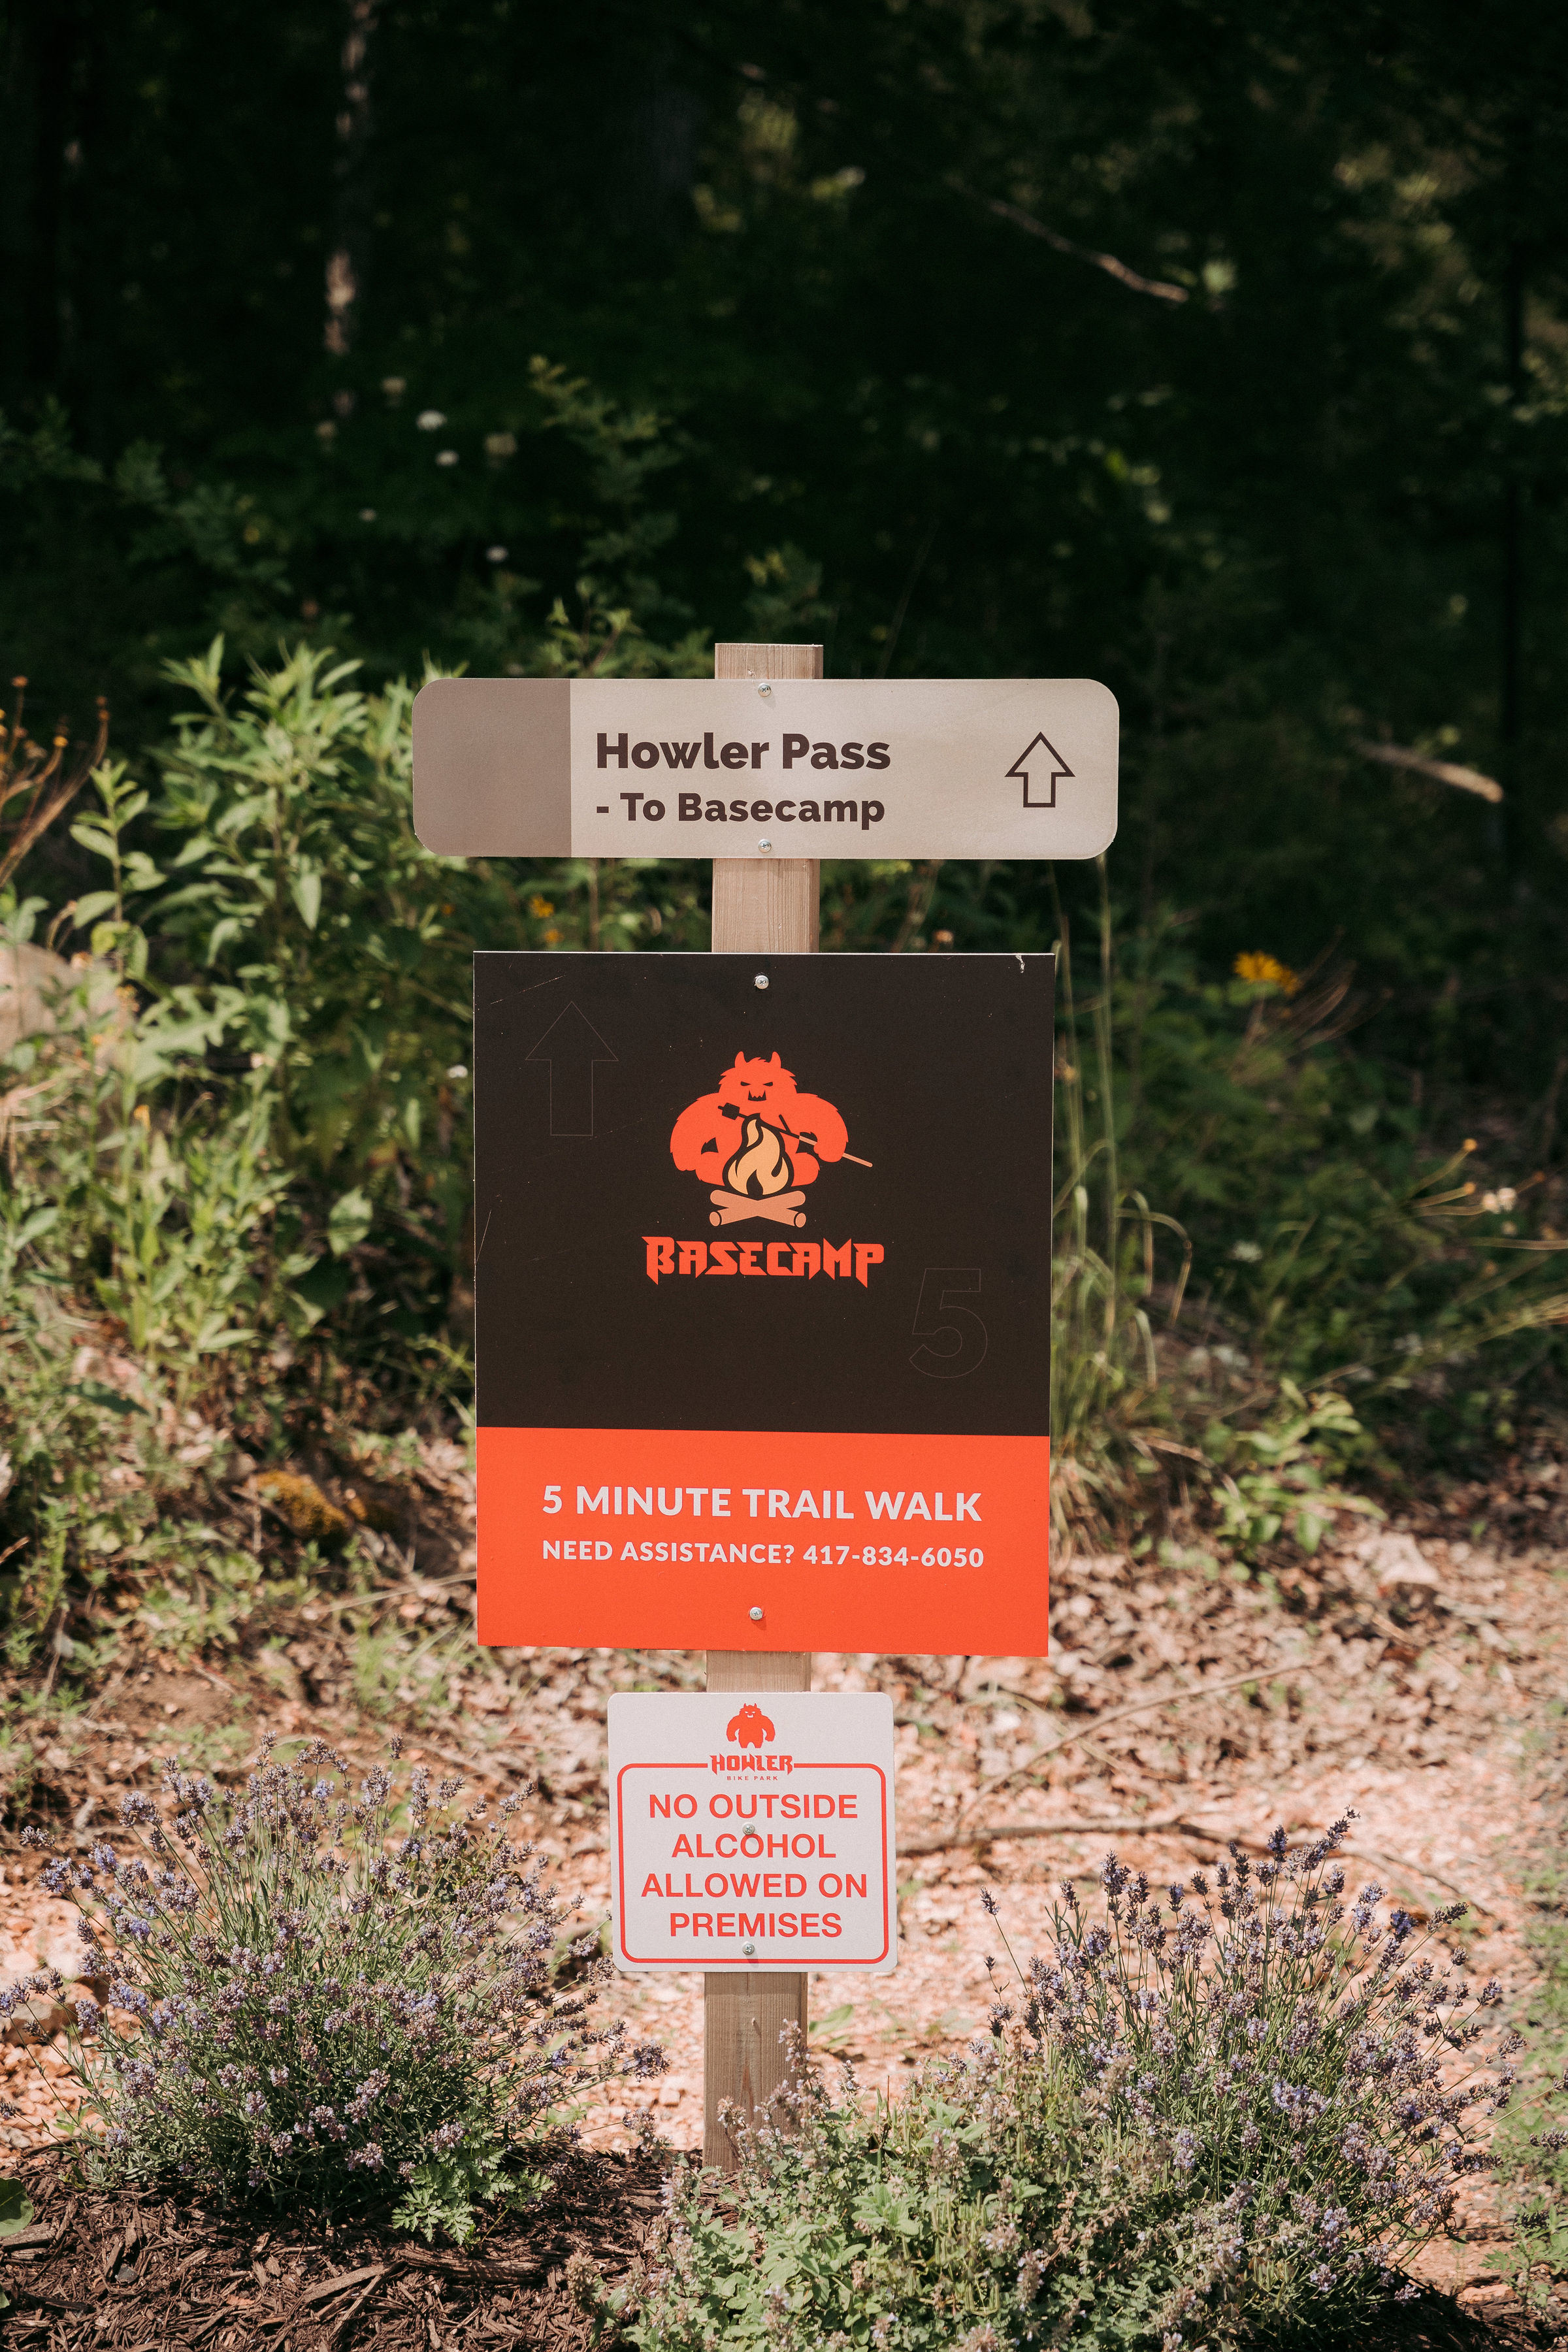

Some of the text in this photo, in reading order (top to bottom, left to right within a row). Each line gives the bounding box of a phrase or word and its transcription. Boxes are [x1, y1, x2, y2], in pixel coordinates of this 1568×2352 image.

[596, 731, 891, 770] Howler Pass
[596, 792, 886, 831] - To Basecamp
[642, 1236, 885, 1288] BASECAMP
[542, 1485, 982, 1522] 5 MINUTE TRAIL WALK
[542, 1541, 984, 1568] NEED ASSISTANCE? 417-834-6050
[710, 1753, 793, 1775] HOWLER
[649, 1793, 858, 1819] NO OUTSIDE
[671, 1833, 836, 1858] ALCOHOL
[641, 1873, 867, 1898] ALLOWED ON
[670, 1912, 842, 1937] PREMISES
